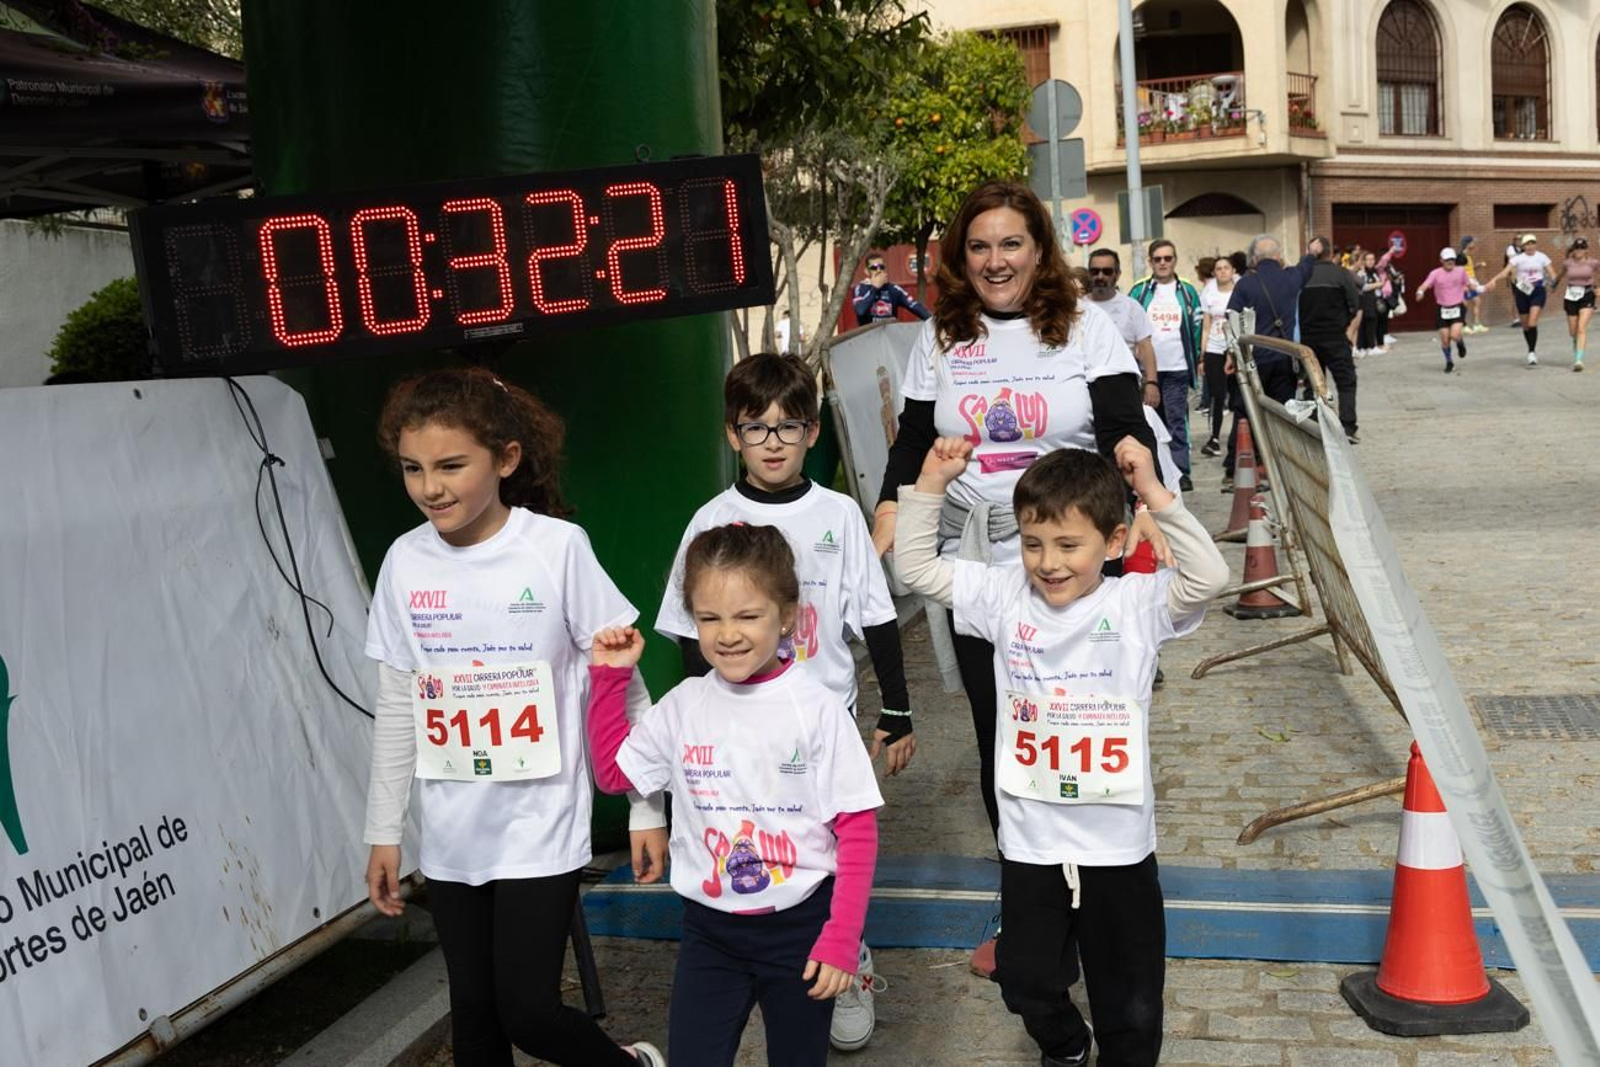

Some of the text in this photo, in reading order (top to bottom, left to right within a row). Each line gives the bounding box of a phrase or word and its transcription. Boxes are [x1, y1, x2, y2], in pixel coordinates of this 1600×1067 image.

[7, 78, 57, 93] Patronato
[57, 80, 101, 95] Municipal
[258, 179, 747, 347] 00:32:21
[1152, 313, 1179, 322] 5498
[410, 590, 447, 609] XXVII
[433, 612, 463, 621] POPULAR
[453, 669, 534, 684] XXVII CARRERA POPULAR
[1050, 703, 1127, 712] XXVII CARRERA POPULAR
[426, 704, 544, 747] 5114
[473, 750, 488, 758] NOA
[1014, 730, 1129, 773] 5115
[1059, 774, 1077, 782] IVAN
[16, 825, 153, 912] Municipal
[157, 815, 188, 849] de
[71, 905, 107, 941] de
[112, 871, 176, 922] Jaén
